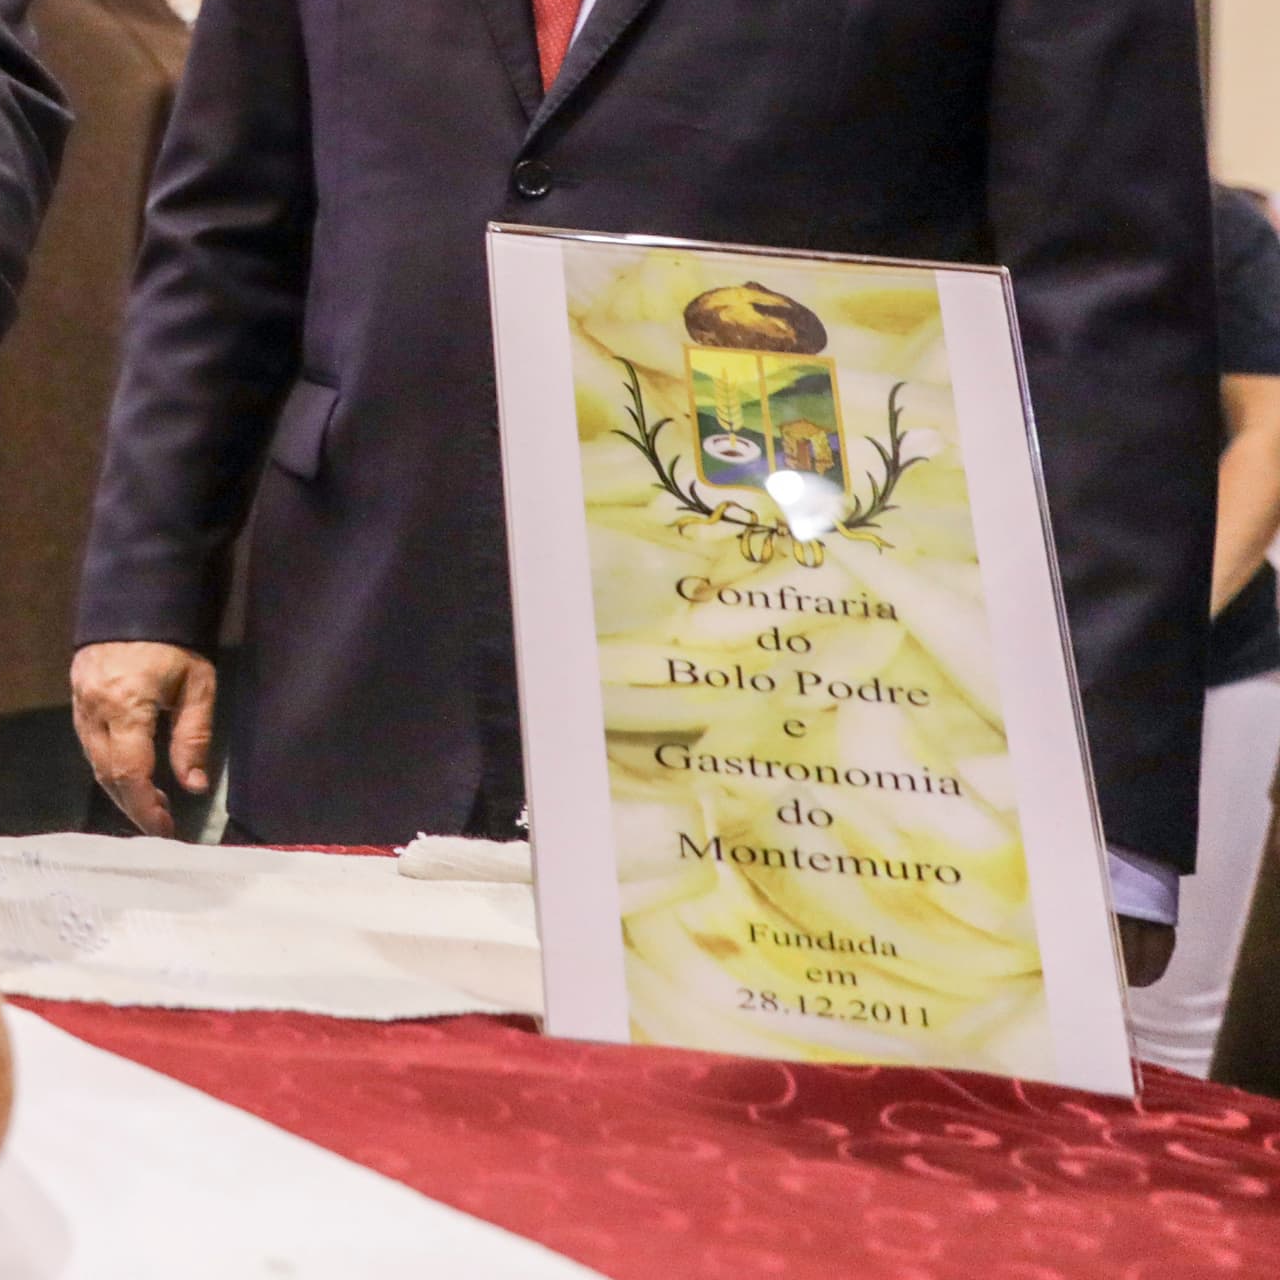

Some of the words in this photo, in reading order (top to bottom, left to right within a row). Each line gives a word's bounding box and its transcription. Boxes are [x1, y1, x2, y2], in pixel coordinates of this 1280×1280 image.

[675, 575, 899, 622] Confraria
[756, 626, 812, 654] do
[664, 657, 776, 692] Bolo
[794, 669, 930, 707] Podre
[783, 719, 807, 738] e
[654, 742, 963, 797] Gastronomia
[776, 798, 834, 828] do
[678, 831, 962, 885] Montemuro
[748, 922, 898, 957] Fundada
[806, 968, 858, 986] em
[736, 987, 930, 1028] 28.12.2011
